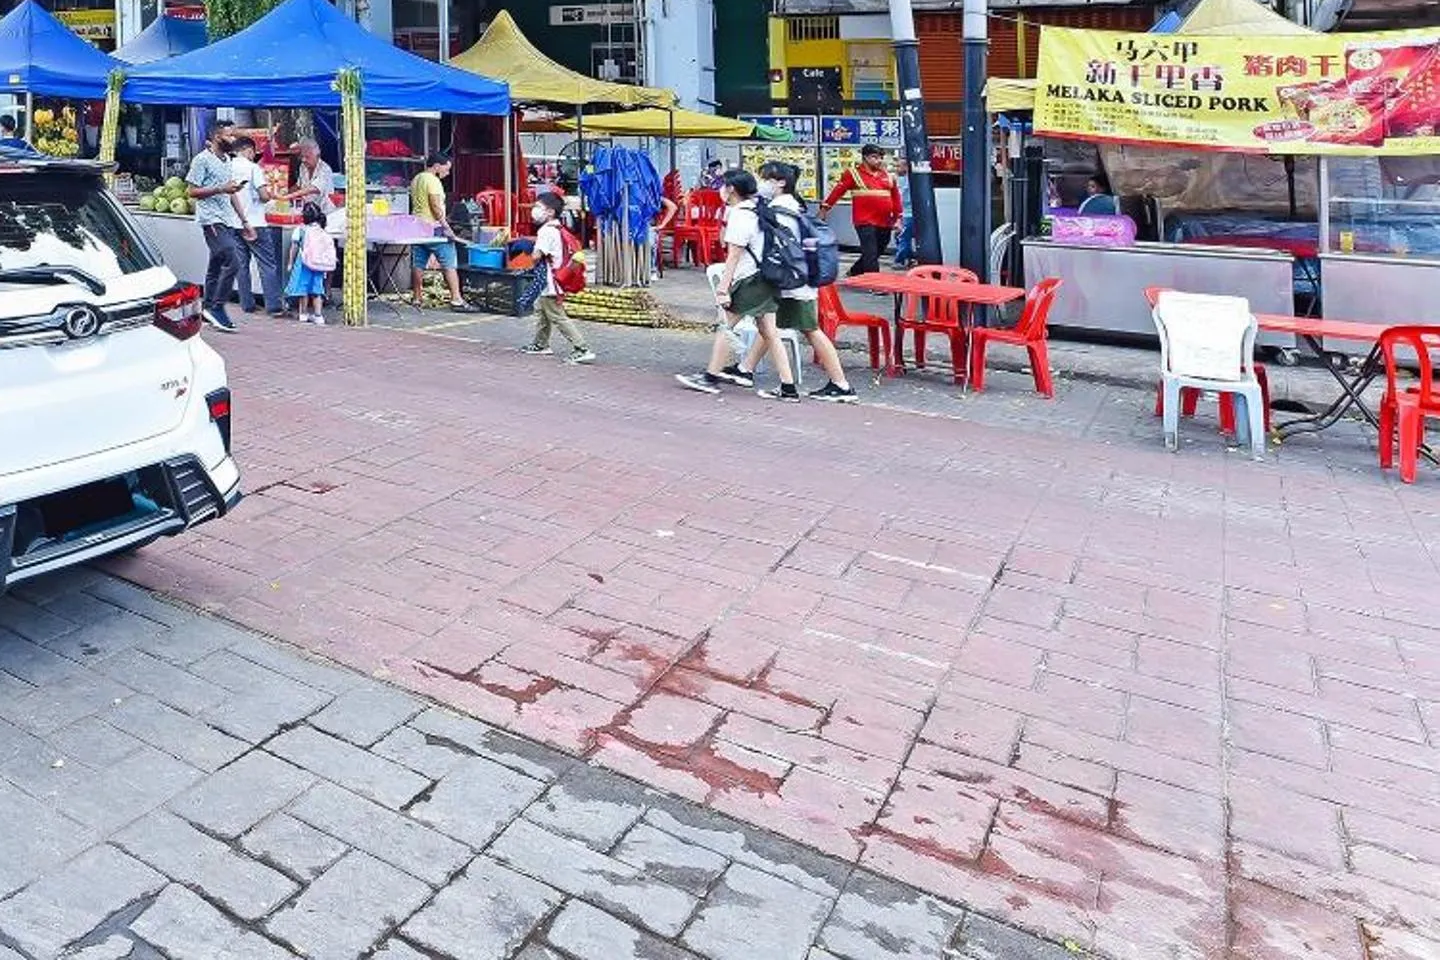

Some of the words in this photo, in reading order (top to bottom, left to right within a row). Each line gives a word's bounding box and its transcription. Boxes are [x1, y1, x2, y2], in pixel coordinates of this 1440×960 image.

[1115, 40, 1198, 63] 马六甲
[1243, 54, 1340, 77] 猪肉干
[1046, 83, 1125, 105] MELAKA
[1131, 90, 1202, 110] SLICED
[1208, 96, 1270, 113] PORK
